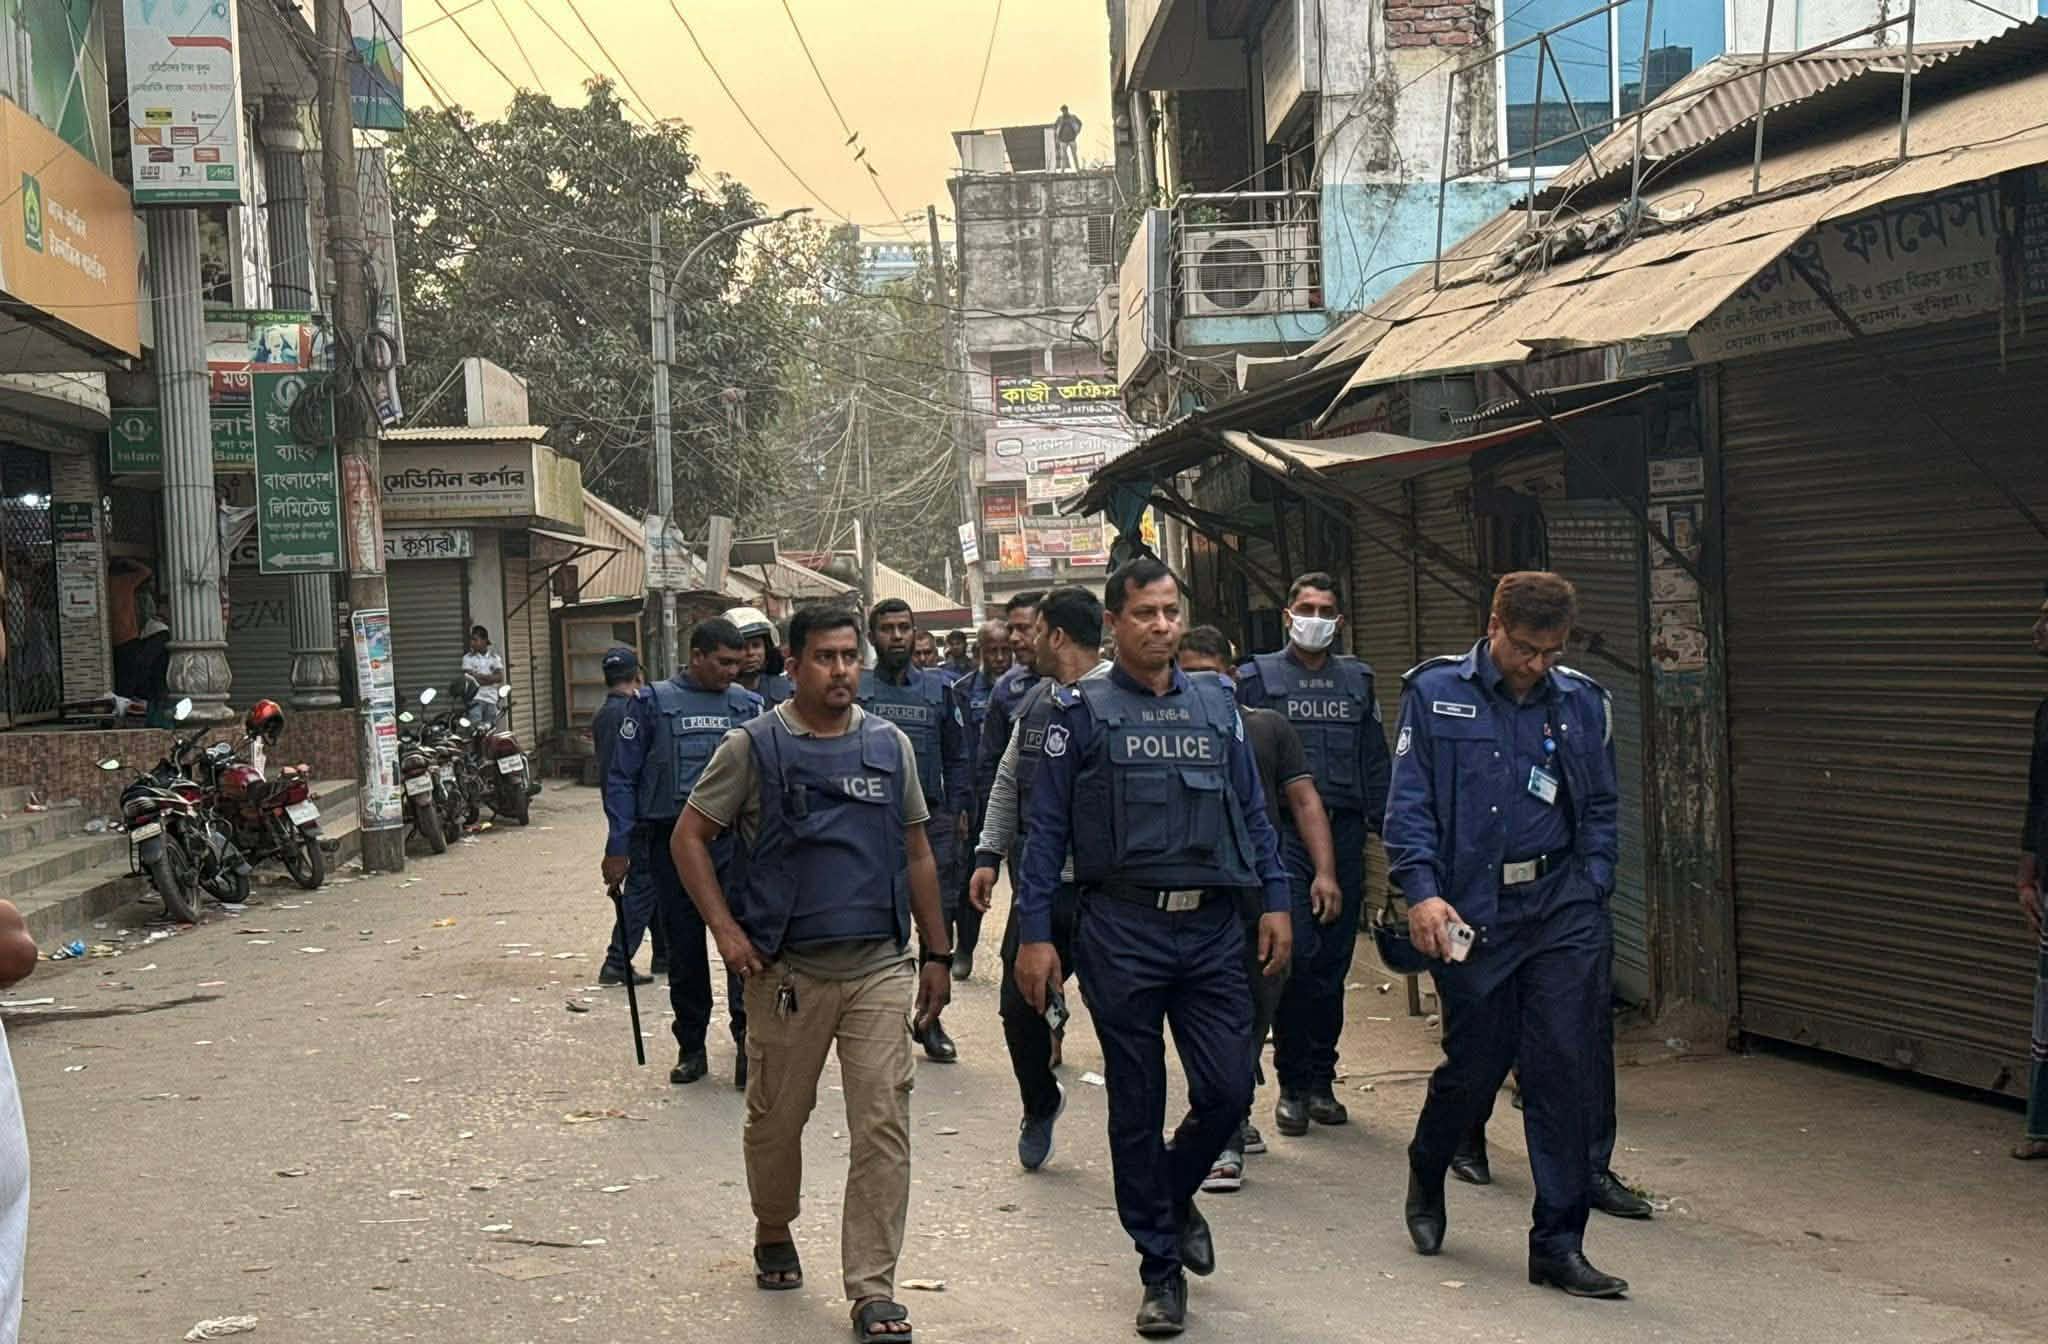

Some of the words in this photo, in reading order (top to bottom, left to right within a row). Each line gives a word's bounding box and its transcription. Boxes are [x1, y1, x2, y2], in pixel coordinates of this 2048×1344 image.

[999, 381, 1052, 404] কাজী
[1057, 380, 1120, 399] অফিস
[263, 472, 333, 491] বাংলাদেশ
[383, 468, 463, 492] মেডিসিন
[466, 465, 525, 487] কর্ণার
[267, 496, 333, 519] লিমিটেড
[881, 705, 922, 719] POLICE
[1288, 700, 1351, 718] POLICE
[1126, 735, 1213, 759] POLICE
[844, 777, 885, 798] ICE
